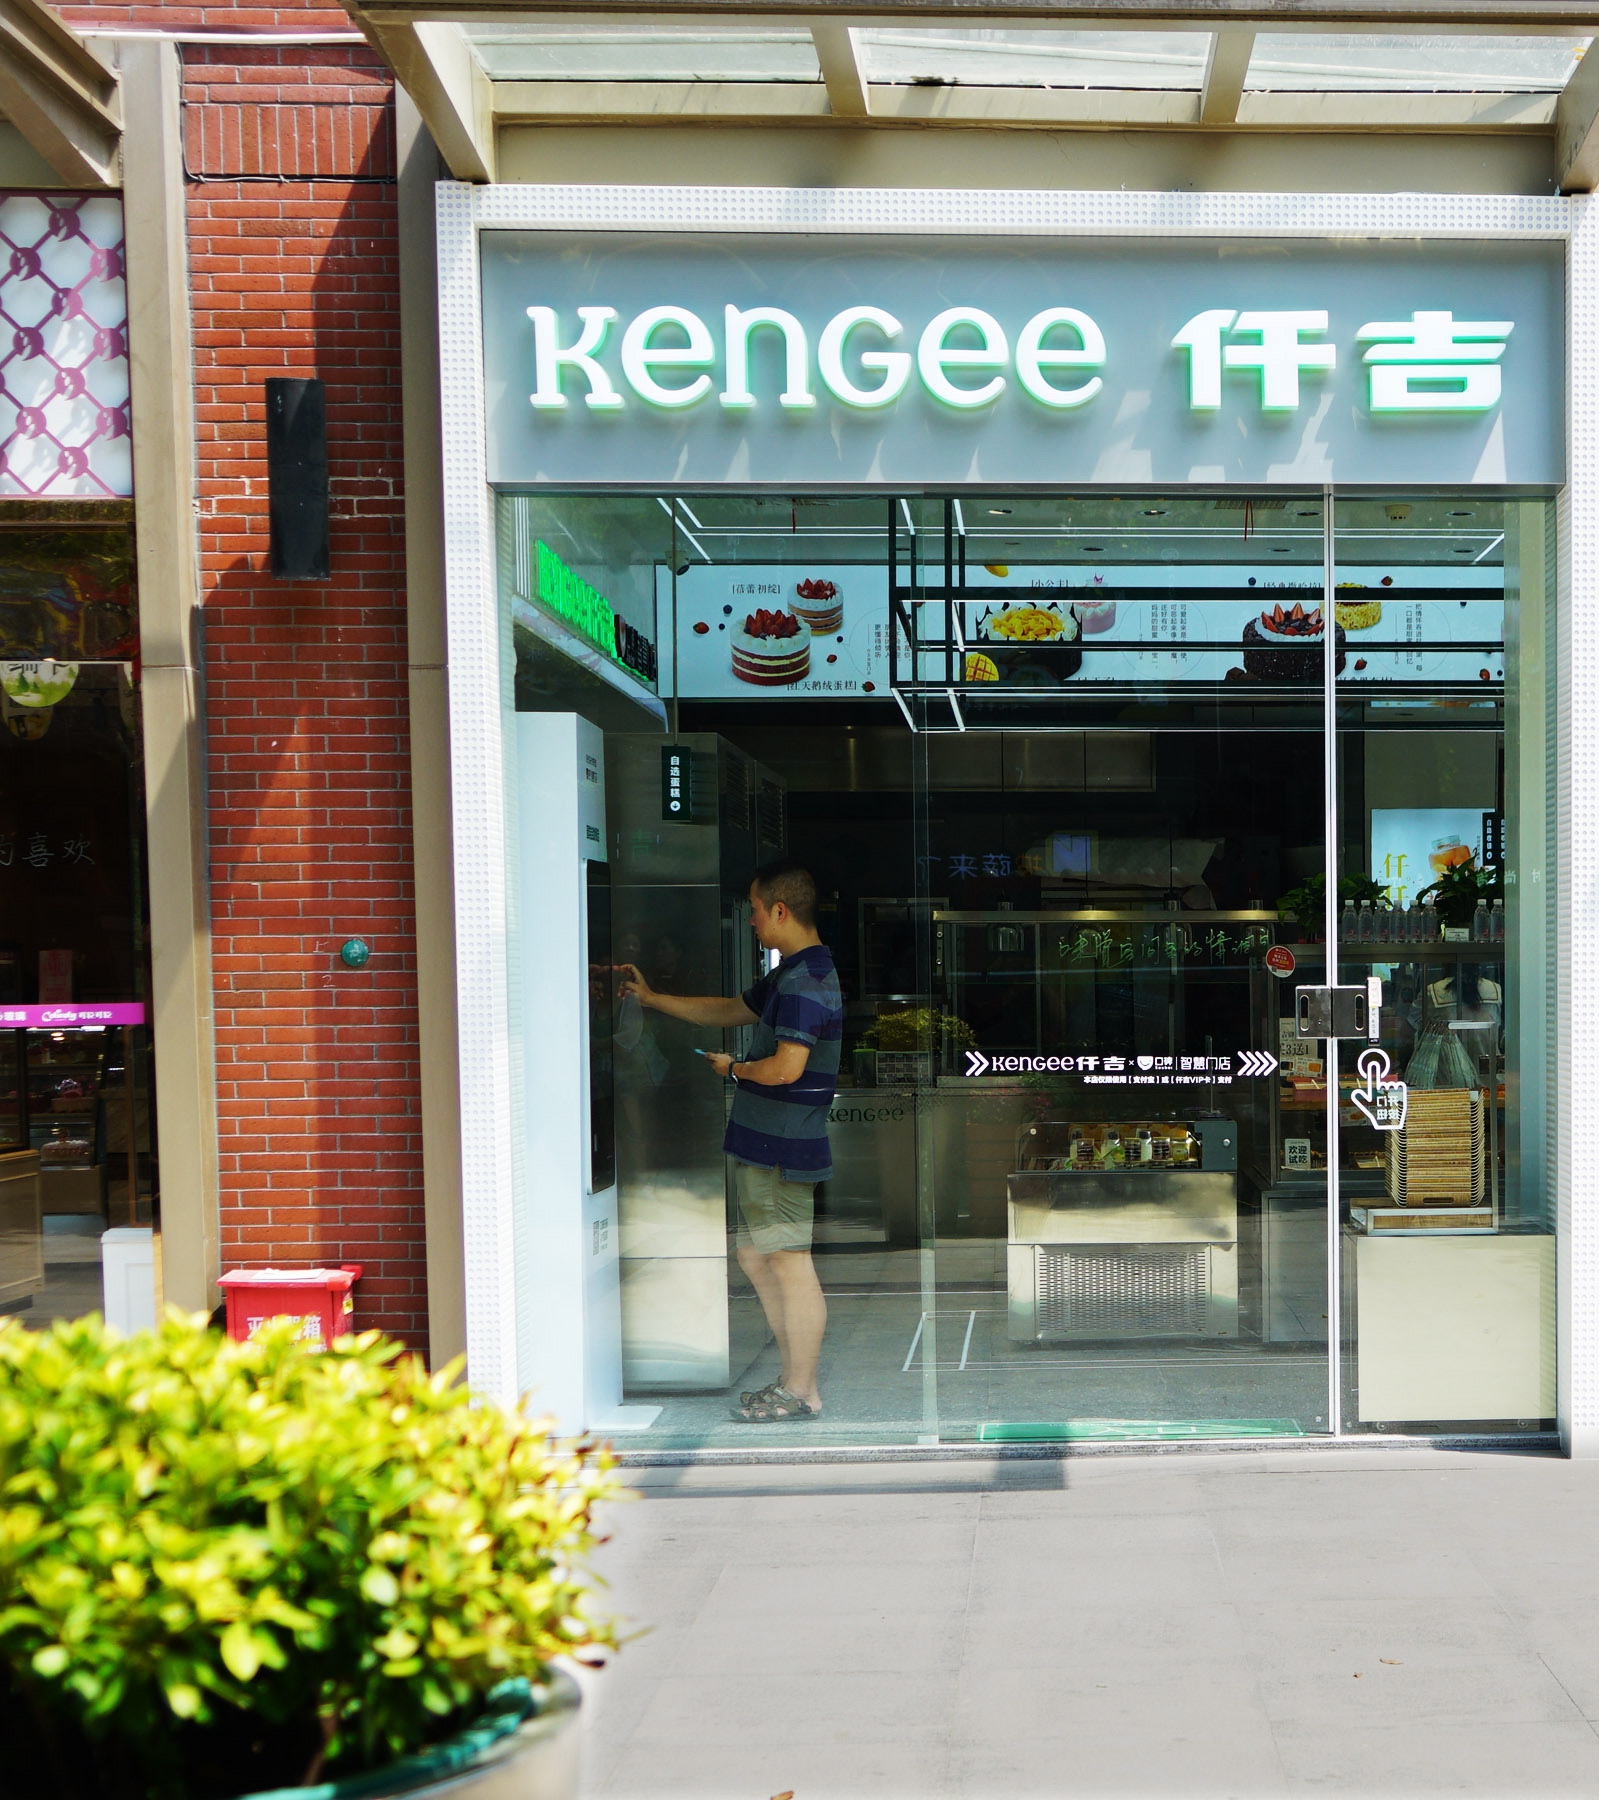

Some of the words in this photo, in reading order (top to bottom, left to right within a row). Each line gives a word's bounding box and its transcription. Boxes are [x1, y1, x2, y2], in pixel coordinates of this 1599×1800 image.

[1171, 308, 1516, 412] 仟吉
[670, 756, 680, 798] 自选蛋糕
[1075, 1056, 1126, 1071] 仟吉
[1180, 1056, 1231, 1071] 智慧门店
[1288, 1145, 1307, 1155] 欢迎
